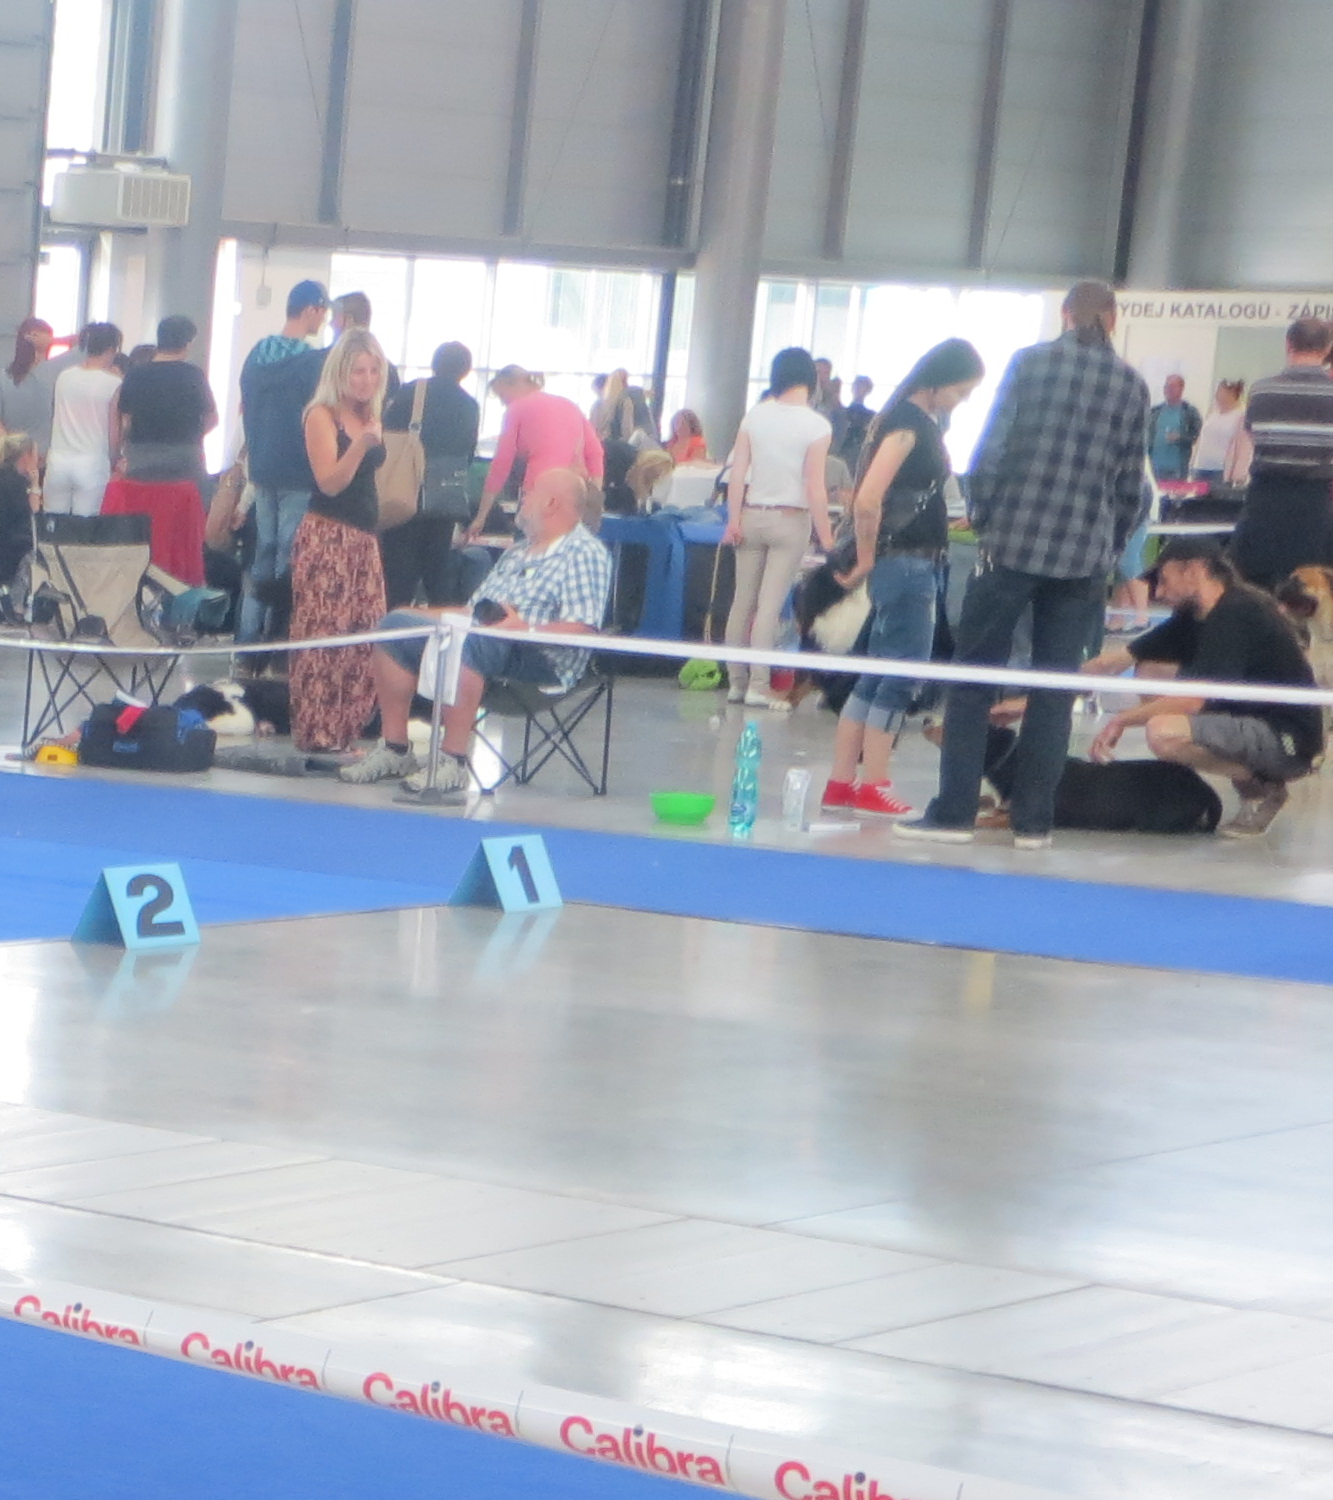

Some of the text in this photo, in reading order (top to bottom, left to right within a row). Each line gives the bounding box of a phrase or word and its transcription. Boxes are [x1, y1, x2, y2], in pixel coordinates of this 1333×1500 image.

[1117, 299, 1165, 318] ÝDEJ
[1287, 299, 1333, 319] ZÁPI
[126, 873, 185, 938] 2
[507, 845, 540, 904] 1
[363, 1372, 515, 1437] Calibra
[559, 1415, 726, 1485] Calibra
